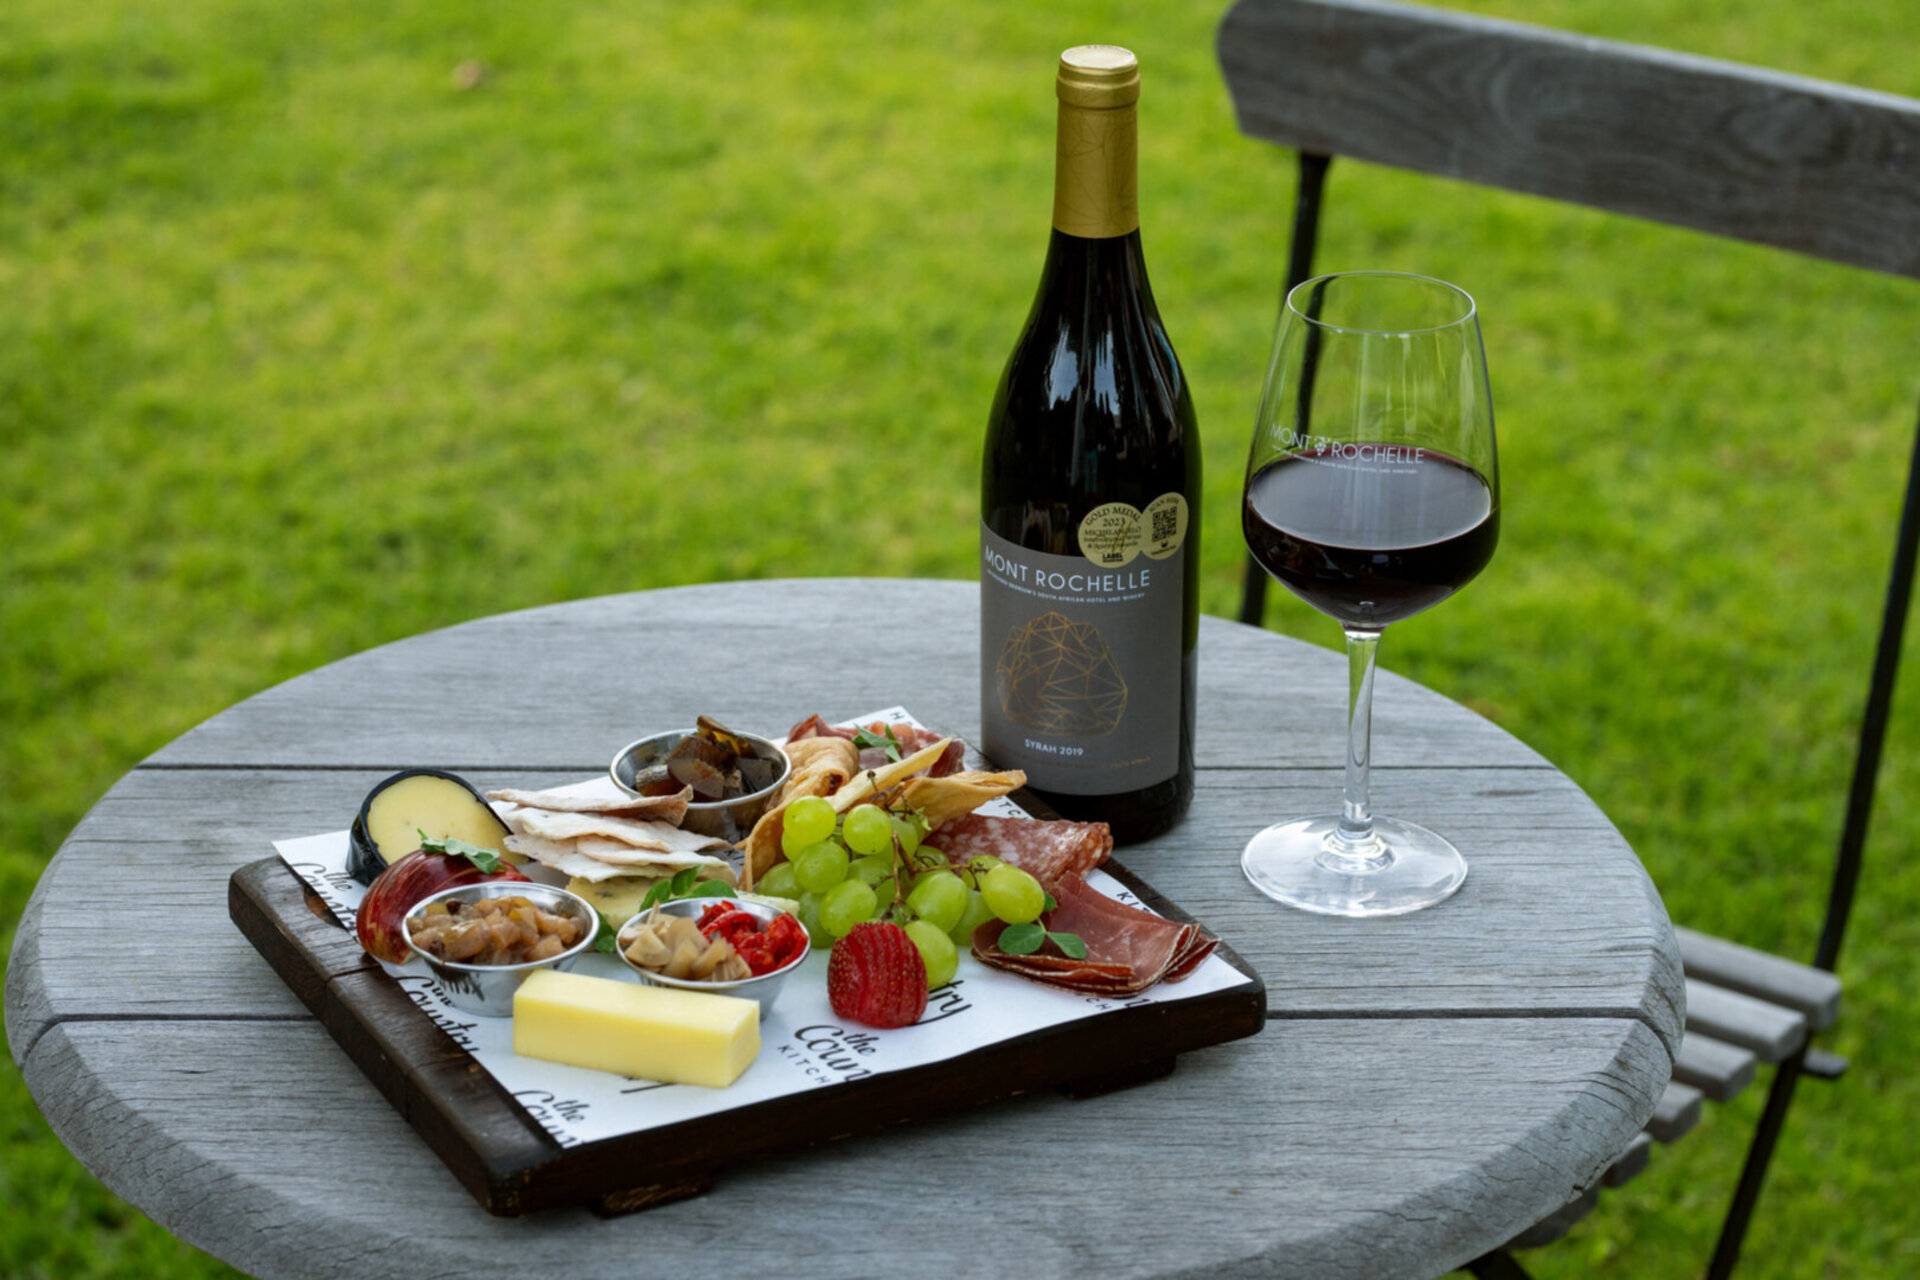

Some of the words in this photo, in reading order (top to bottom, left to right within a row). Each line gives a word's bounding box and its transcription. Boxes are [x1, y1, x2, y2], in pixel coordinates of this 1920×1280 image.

[1270, 423, 1312, 451] MONT
[1331, 441, 1425, 464] ROCHELLE
[1085, 508, 1110, 526] GOLD
[1102, 517, 1126, 527] 2023
[985, 545, 1028, 582] MONT
[1036, 569, 1151, 592] ROCHELLE
[1024, 738, 1057, 754] SYRAH
[1059, 745, 1084, 756] 2019
[843, 1031, 881, 1057] the
[552, 1100, 590, 1124] the
